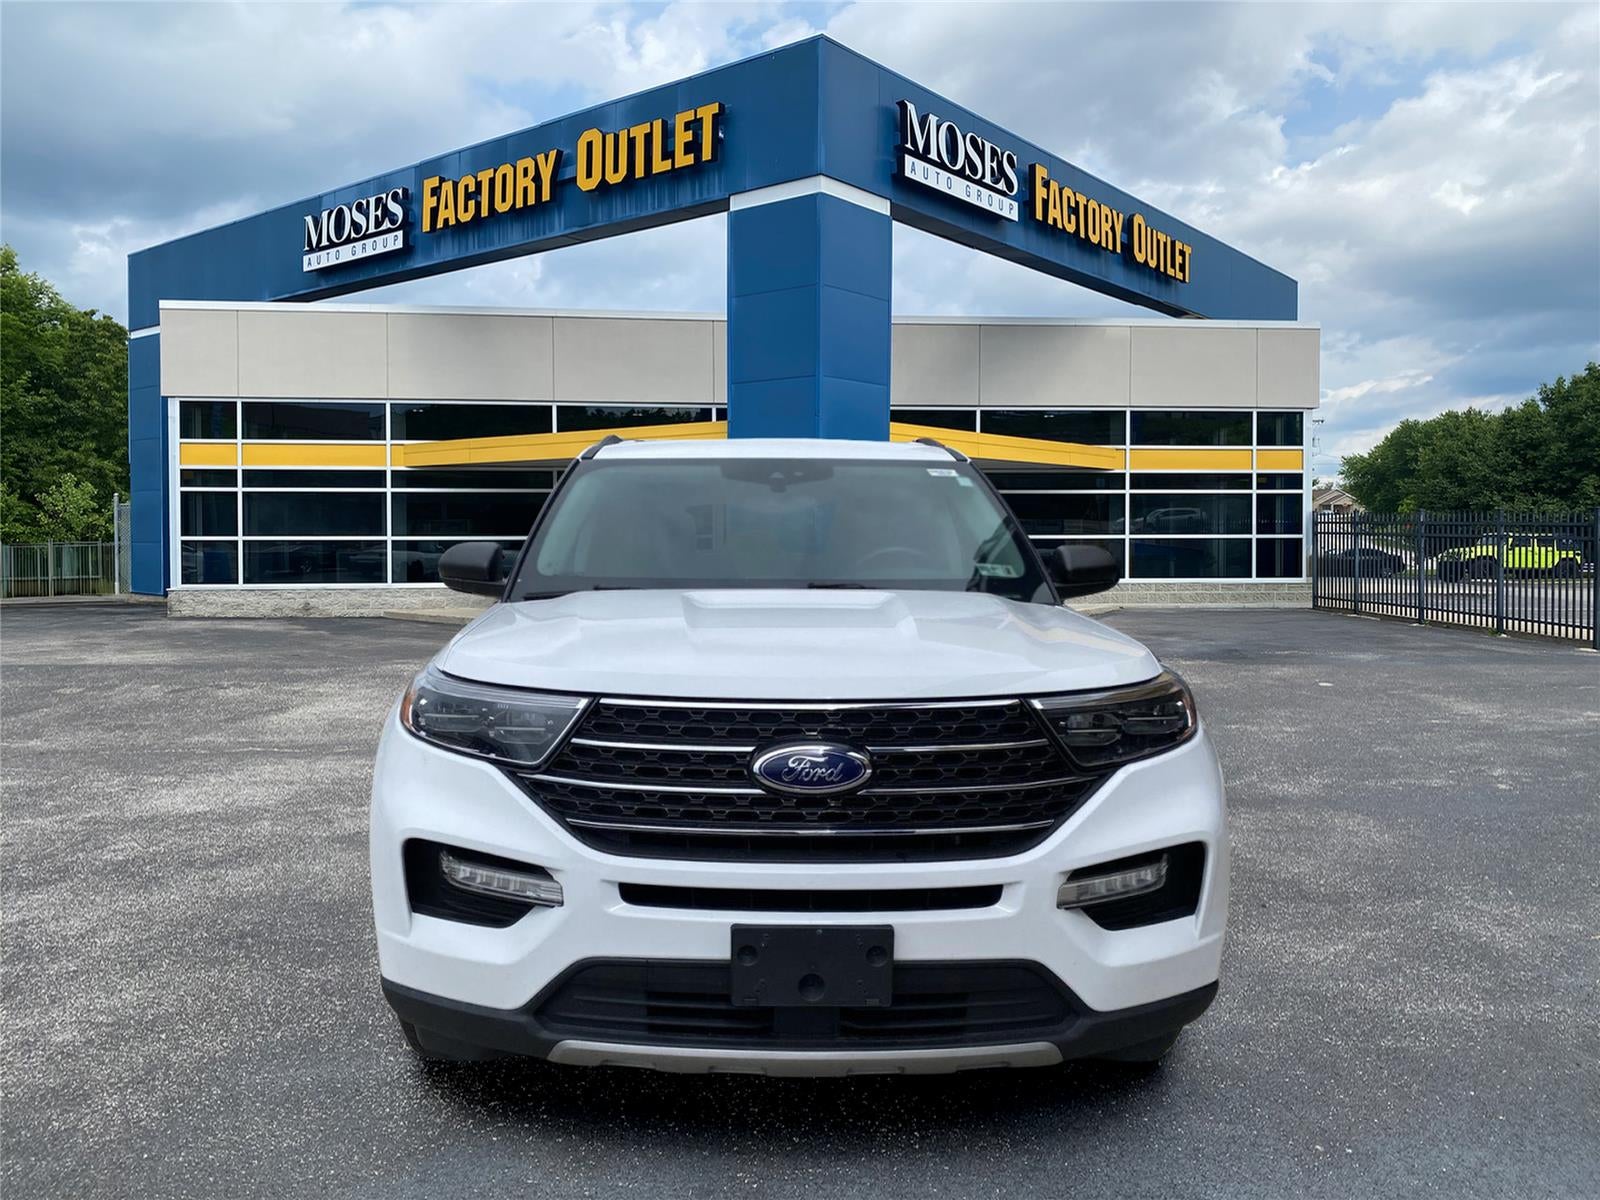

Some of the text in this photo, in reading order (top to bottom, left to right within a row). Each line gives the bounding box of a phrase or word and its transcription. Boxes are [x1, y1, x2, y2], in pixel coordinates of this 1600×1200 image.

[422, 102, 720, 233] FACTORY OUTLET
[905, 100, 1018, 196] MOSES
[303, 188, 404, 251] MOSES
[910, 161, 1015, 216] AUTO GROUP
[306, 234, 400, 269] AUTO GROUP
[1035, 163, 1192, 284] FACTORY OUTLET
[781, 754, 844, 782] Ford
